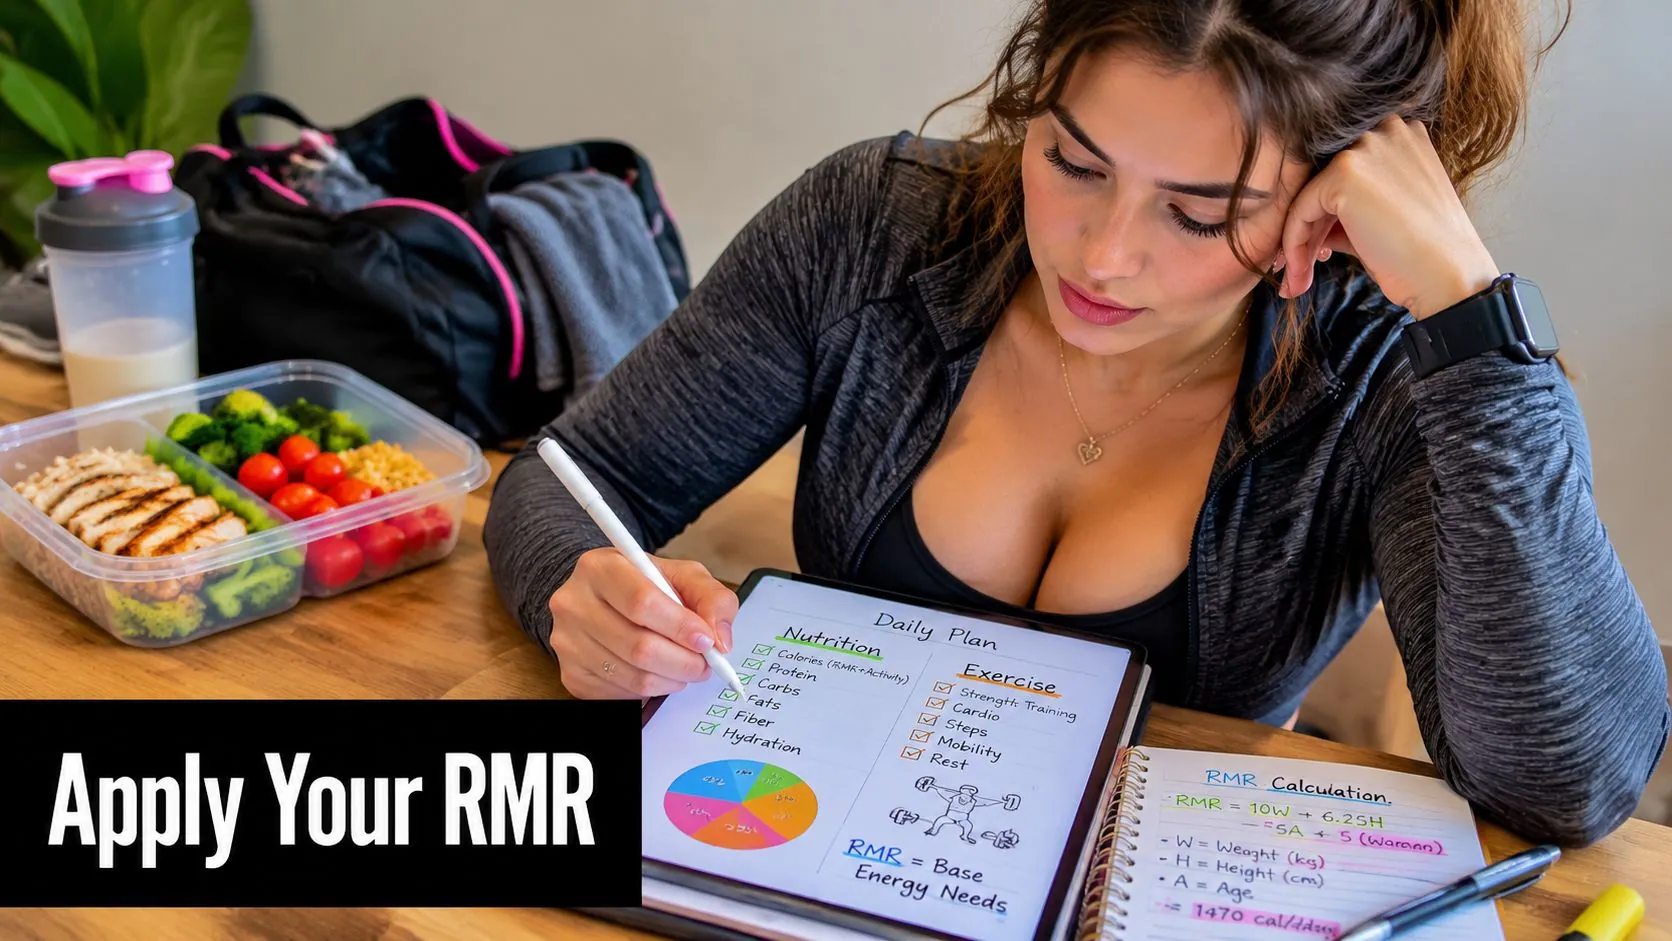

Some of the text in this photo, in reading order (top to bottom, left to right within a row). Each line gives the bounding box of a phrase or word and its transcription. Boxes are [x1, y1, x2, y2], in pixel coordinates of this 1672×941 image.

[783, 626, 881, 657] Nutrition
[873, 612, 999, 651] Daily Plan
[777, 649, 824, 667] Calories
[768, 662, 818, 682] Protein
[963, 663, 1057, 694] Exercise
[758, 678, 801, 697] Carbs
[747, 693, 782, 711] Fats
[953, 702, 1001, 722] Cardio
[1025, 700, 1077, 724] Training
[734, 710, 775, 728] Fiber
[945, 719, 988, 738] Steps
[722, 727, 801, 756] Hydration
[937, 735, 1002, 763] Mobility
[929, 752, 969, 771] Rest
[1205, 769, 1258, 787] RMR
[1175, 794, 1223, 810] RMR
[1250, 802, 1290, 817] 10W
[847, 838, 903, 865] RMR
[933, 857, 984, 883] Base
[1176, 834, 1194, 849] W
[1287, 850, 1326, 871] (kg)
[1176, 853, 1190, 868] H
[1216, 859, 1276, 883] Height
[1283, 869, 1324, 889] (cm)
[854, 863, 1009, 914] Energy Needs
[1173, 874, 1189, 889] A
[1216, 881, 1254, 904] Age
[1195, 903, 1244, 922] 1470
